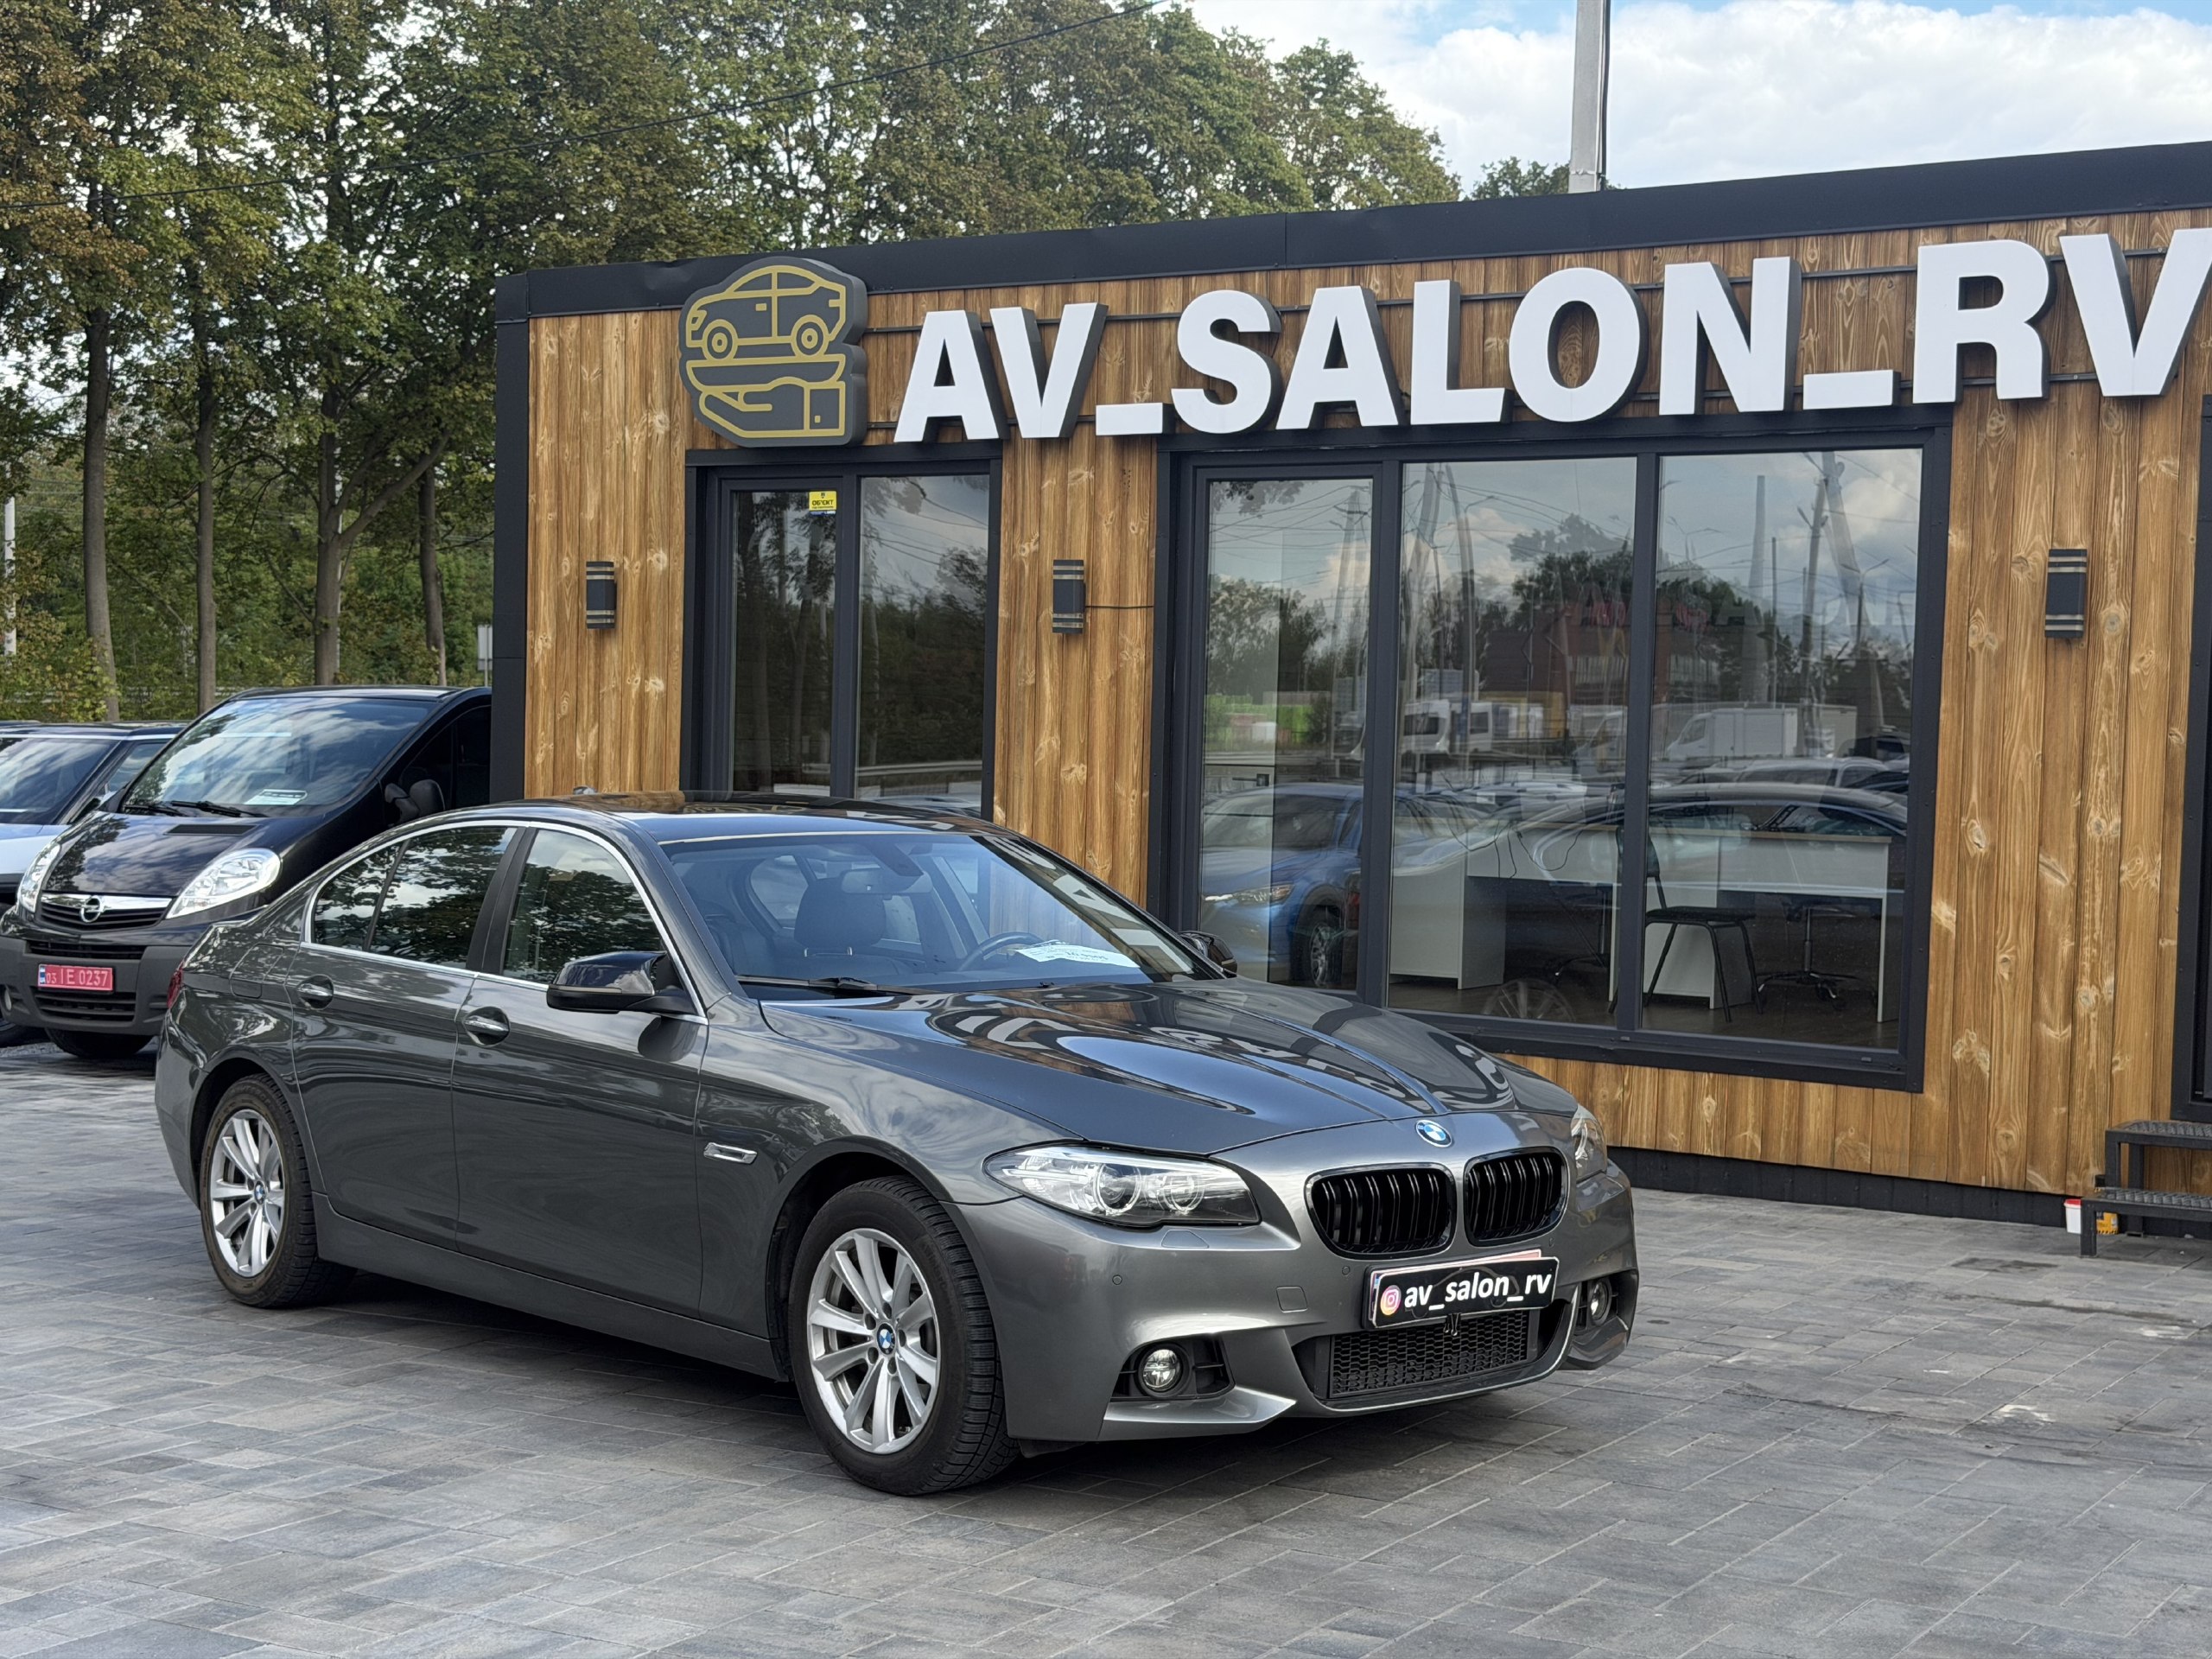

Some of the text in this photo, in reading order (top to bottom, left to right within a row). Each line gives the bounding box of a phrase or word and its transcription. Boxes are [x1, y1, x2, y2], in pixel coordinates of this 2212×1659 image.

[893, 228, 2212, 442] AV_SALON_RV
[79, 969, 108, 987] 0237
[1404, 1271, 1553, 1311] av_salon_rv
